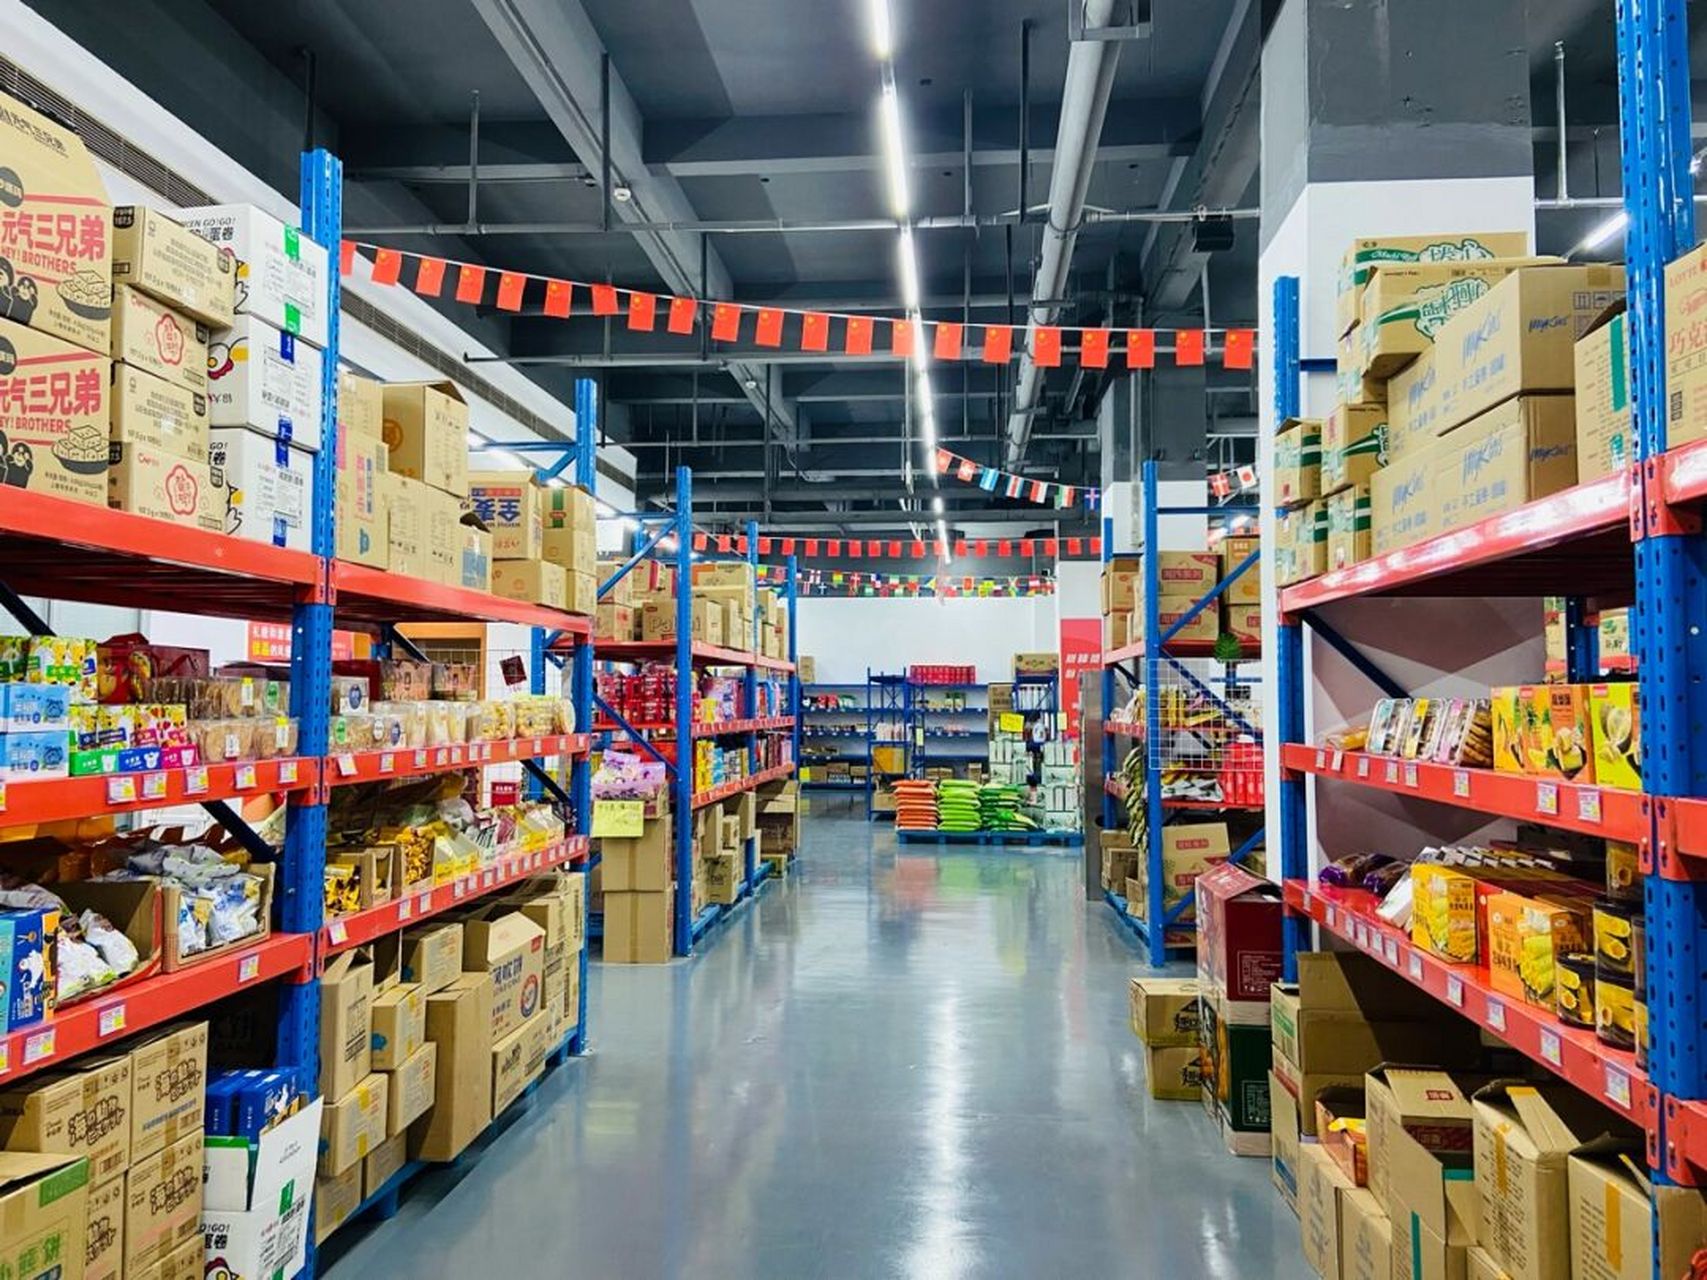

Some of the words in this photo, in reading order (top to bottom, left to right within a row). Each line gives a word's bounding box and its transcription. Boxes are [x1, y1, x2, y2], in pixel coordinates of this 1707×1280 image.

[2, 211, 105, 261] 元气三兄弟
[22, 250, 77, 276] BROTHERS
[0, 367, 101, 416] 元气三兄弟
[15, 416, 72, 435] BROTHERS
